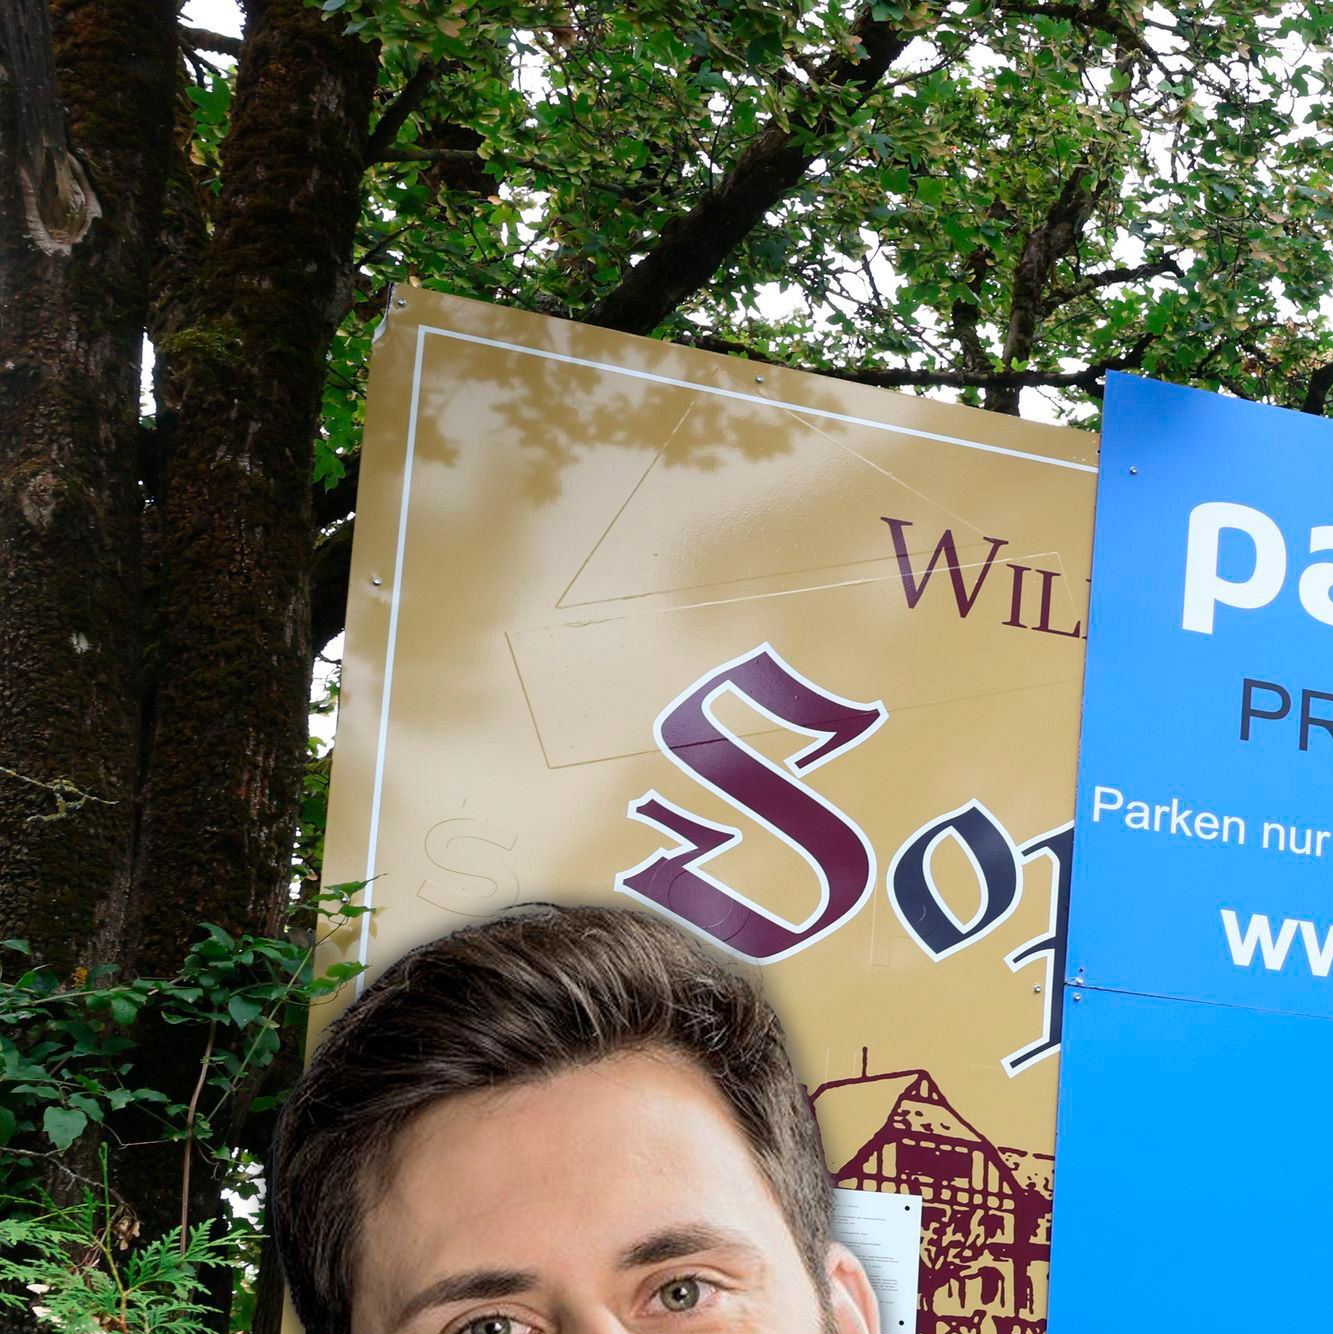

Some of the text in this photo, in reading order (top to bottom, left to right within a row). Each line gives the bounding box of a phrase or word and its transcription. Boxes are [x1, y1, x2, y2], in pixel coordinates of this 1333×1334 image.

[880, 516, 1091, 638] WIL
[1092, 785, 1246, 845] Parken
[1262, 821, 1332, 857] nur
